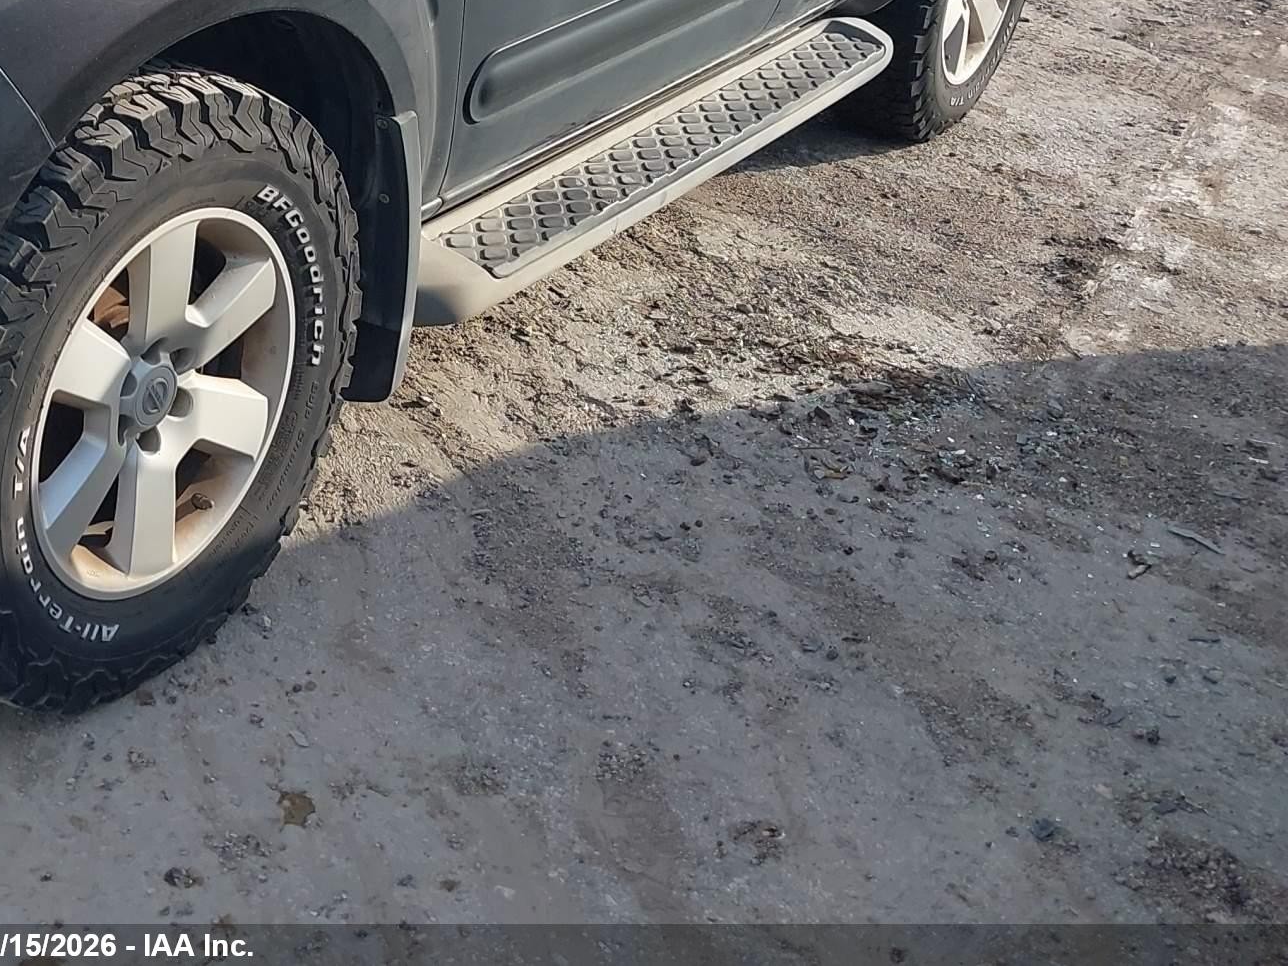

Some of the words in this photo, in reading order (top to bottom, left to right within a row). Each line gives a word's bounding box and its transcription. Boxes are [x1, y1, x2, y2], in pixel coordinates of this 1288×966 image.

[257, 184, 326, 365] BFGoodrich
[13, 425, 31, 499] T/A
[15, 516, 120, 642] All-Terrain
